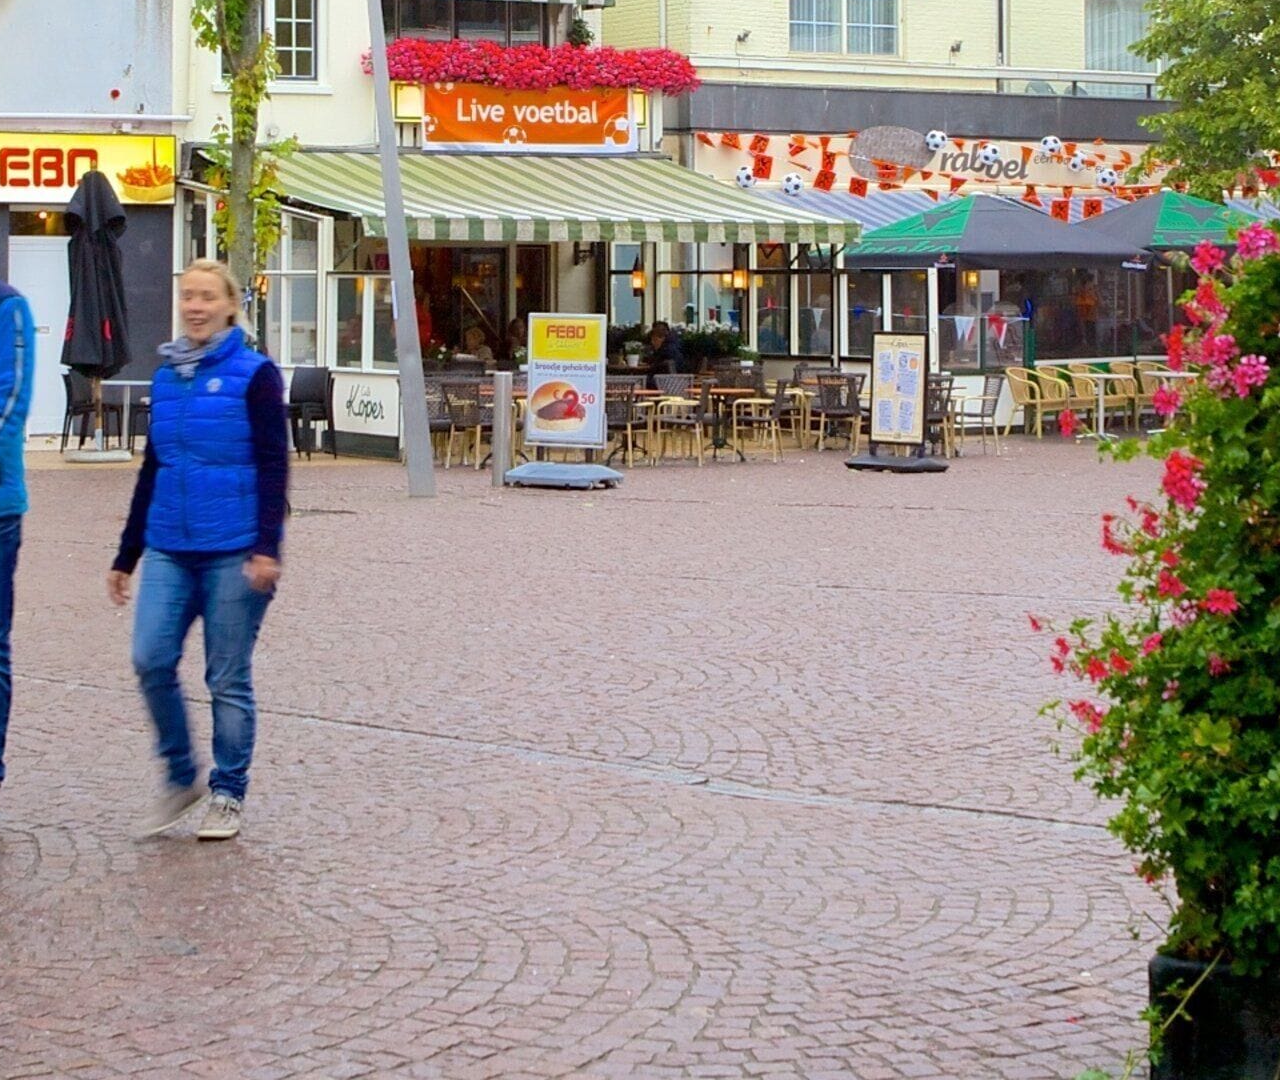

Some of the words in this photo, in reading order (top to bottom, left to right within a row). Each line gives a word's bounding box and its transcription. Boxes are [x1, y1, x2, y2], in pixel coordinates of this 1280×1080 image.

[456, 97, 505, 122] Live
[513, 100, 598, 123] voetbal
[546, 325, 586, 339] FEBO
[562, 389, 579, 419] 2
[581, 393, 595, 405] 50
